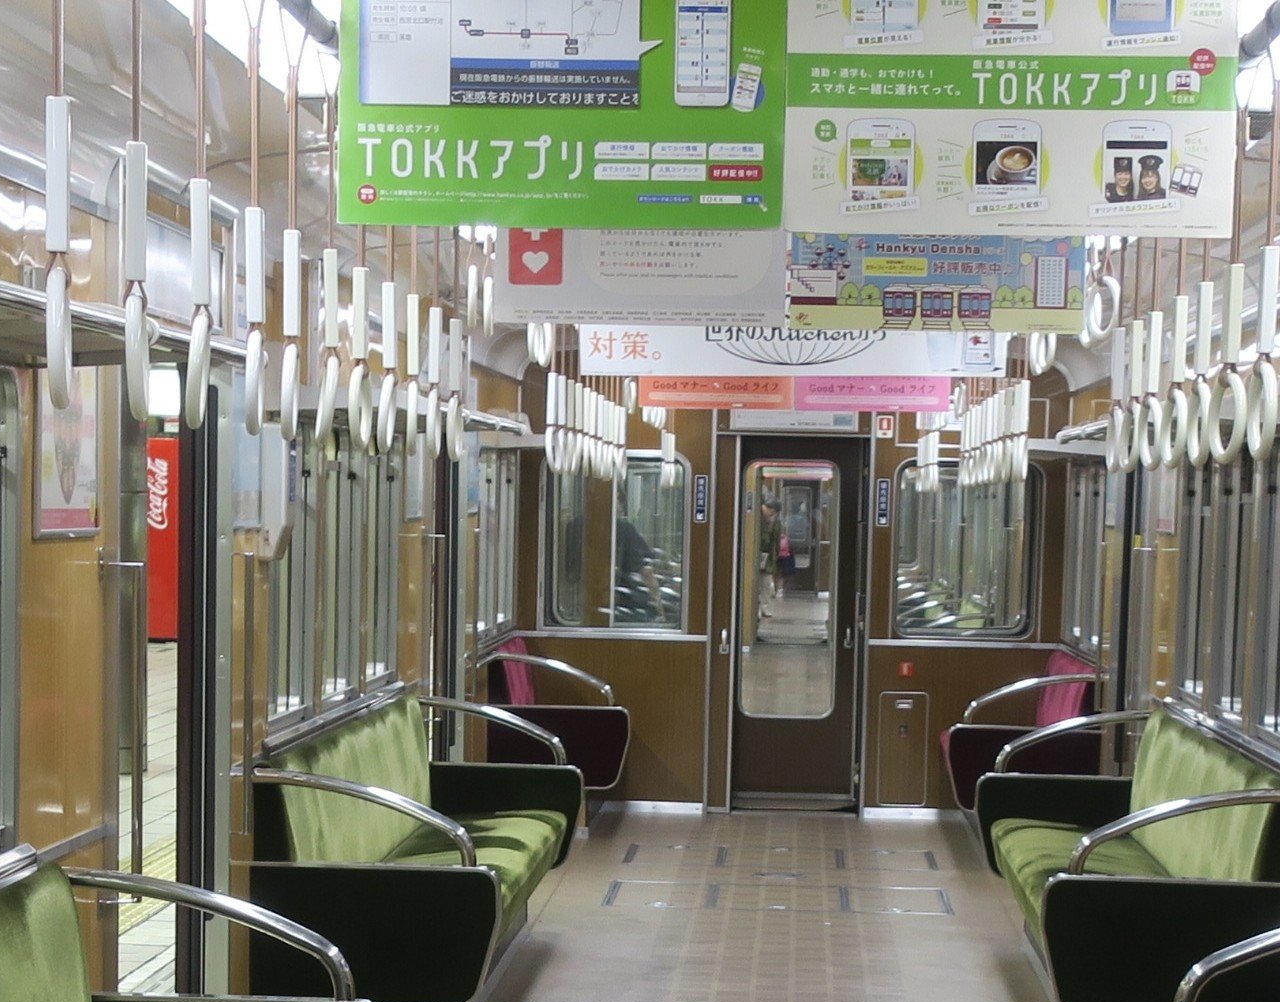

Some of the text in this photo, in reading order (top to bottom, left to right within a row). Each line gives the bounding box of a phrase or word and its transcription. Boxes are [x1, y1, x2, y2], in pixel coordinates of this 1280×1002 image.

[972, 60, 1040, 70] 阪急電車公式
[810, 82, 962, 96] スマホと一緒に連れてって。
[972, 69, 1157, 106] TOKKアプリ
[357, 122, 440, 134] 阪急電車公式アプリ
[357, 134, 584, 181] TOKKアプリ
[876, 243, 926, 255] Hankyu
[930, 242, 981, 254] Densha
[933, 260, 1001, 275] 好評販売中
[588, 331, 662, 361] 対策。
[652, 380, 678, 390] Good
[680, 381, 708, 390] マナー
[723, 382, 749, 392] Good
[808, 382, 835, 393] Good
[837, 383, 865, 393] マナー
[880, 384, 905, 394] Good
